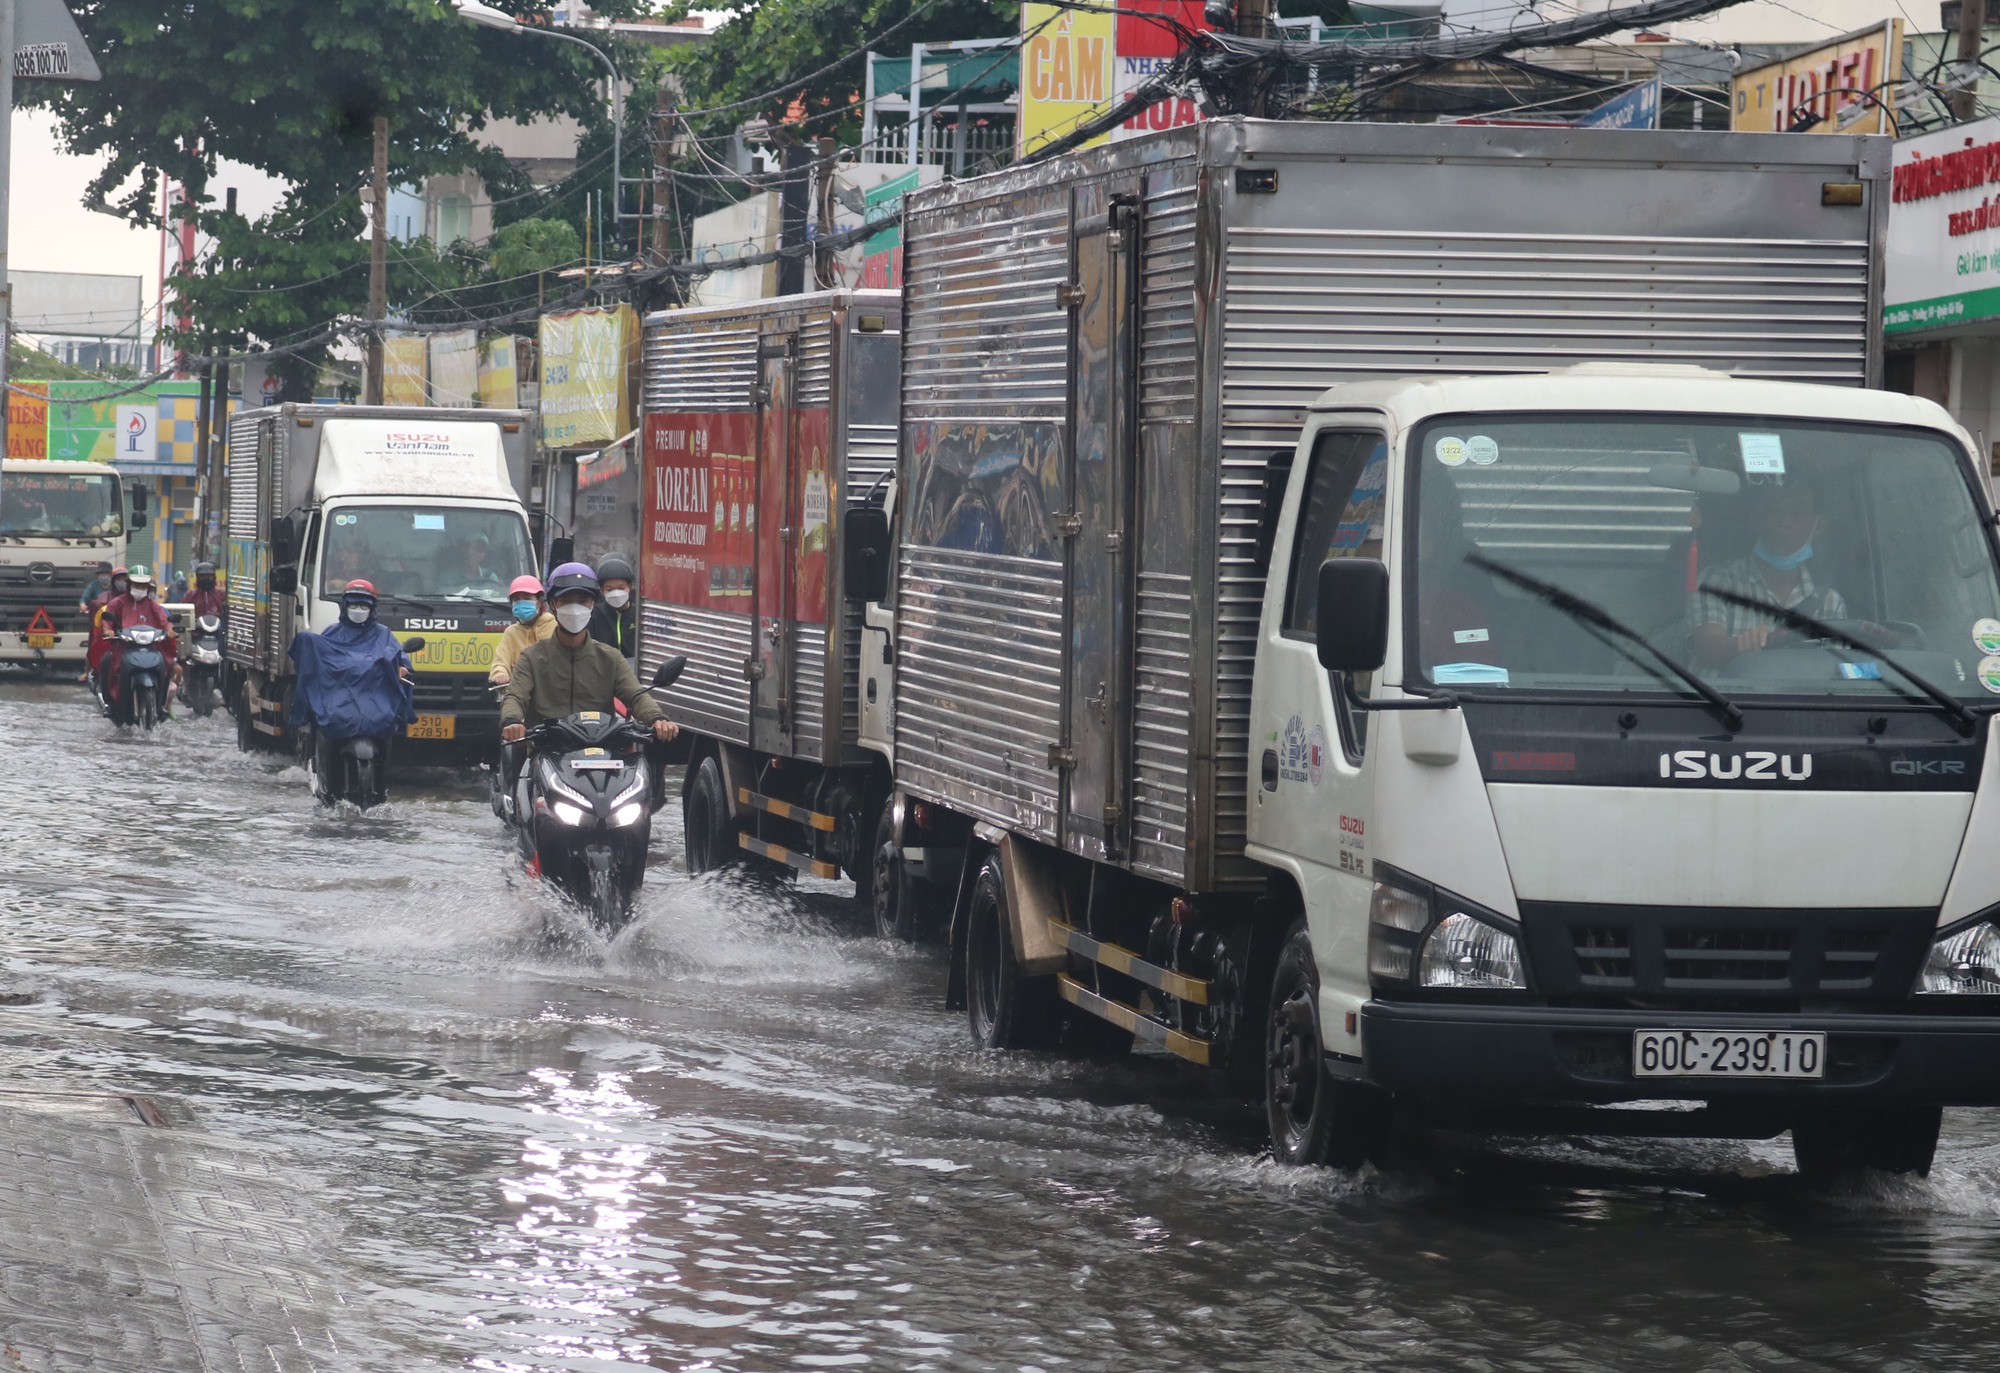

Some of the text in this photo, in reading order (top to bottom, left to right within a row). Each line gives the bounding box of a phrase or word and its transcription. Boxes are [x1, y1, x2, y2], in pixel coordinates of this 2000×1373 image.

[14, 49, 68, 76] 0936.100.700
[1773, 47, 1877, 132] HOTEL
[1972, 250, 1988, 273] làm
[8, 401, 46, 429] TIỆM
[7, 433, 46, 457] VÀNG
[387, 433, 450, 442] ISUZU
[656, 430, 685, 450] PREMIUM
[656, 466, 708, 513] KOREAN
[806, 494, 826, 510] KOREAN
[688, 523, 707, 545] CANDY
[404, 618, 459, 630] ISUZU
[450, 637, 493, 665] BÁO
[412, 727, 449, 738] 278.51
[1659, 750, 1813, 781] ISUZU
[1891, 759, 1965, 775] QKR
[1339, 815, 1365, 835] ISUZU
[1340, 850, 1355, 871] 91
[1640, 1034, 1818, 1074] 60C-239.10
